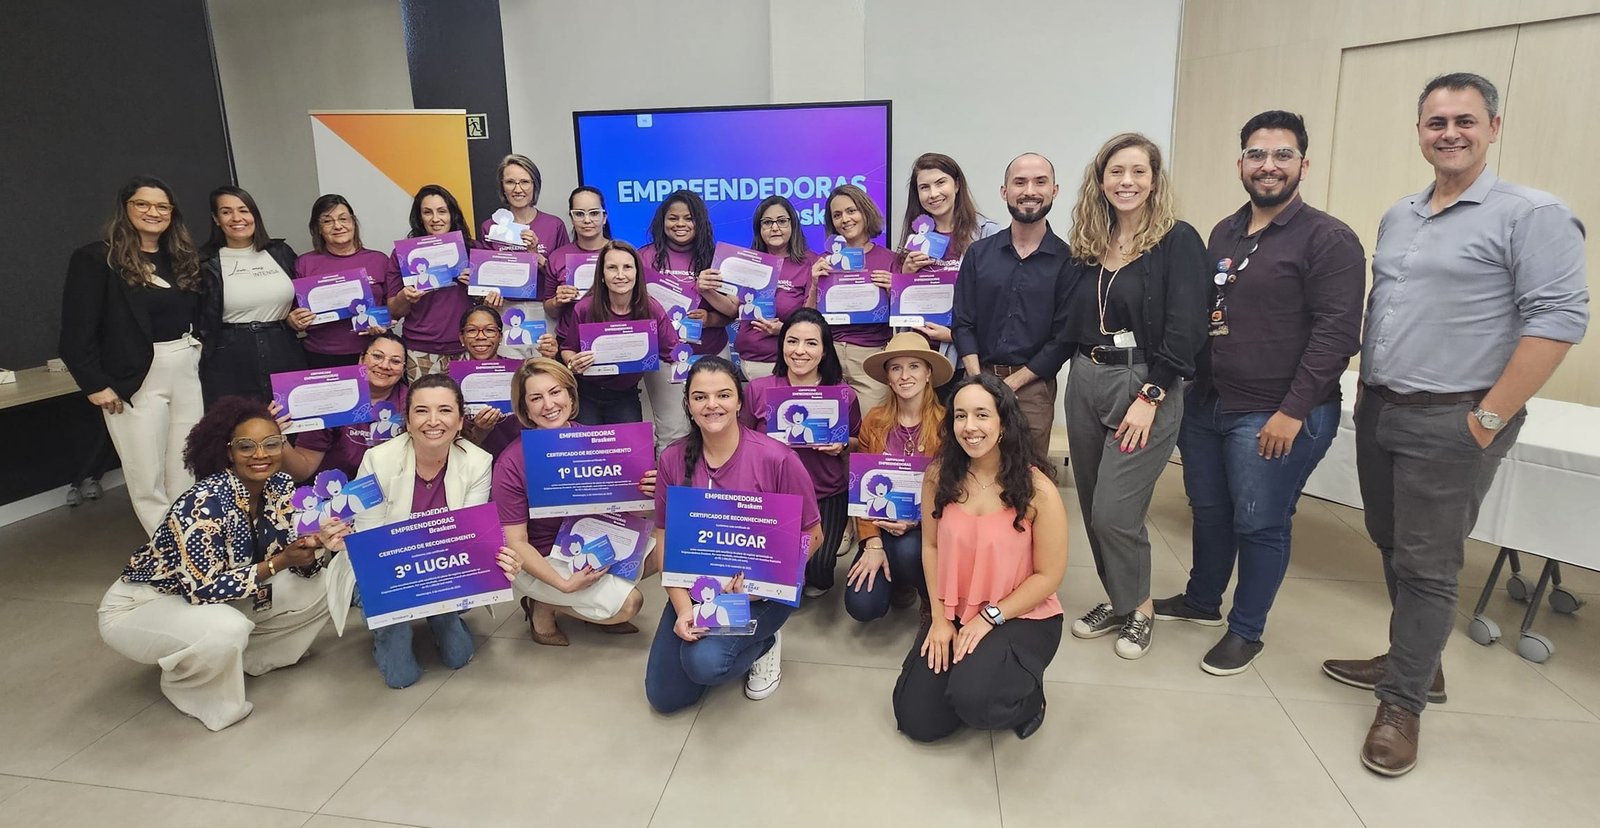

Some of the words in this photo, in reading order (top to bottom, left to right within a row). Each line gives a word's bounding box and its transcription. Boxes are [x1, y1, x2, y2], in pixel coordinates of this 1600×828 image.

[559, 429, 615, 439] EMPREENDEDORAS
[591, 436, 616, 444] Braskem
[546, 450, 578, 458] CERTIFICADO
[586, 447, 632, 456] RECONHECIMENTO
[557, 467, 571, 479] 1º
[574, 465, 622, 478] LUGAR
[704, 493, 763, 503] EMPREENDEDORAS
[737, 502, 763, 511] Braskem
[689, 511, 722, 521] CERTIFICADO
[730, 515, 778, 525] RECONHECIMENTO
[390, 516, 455, 536] EMPREENDEDORAS
[428, 524, 457, 534] Braskem
[698, 530, 713, 543] 2º
[716, 531, 766, 549] LUGAR
[378, 544, 416, 559] CERTIFICADO
[416, 542, 425, 550] DE
[425, 533, 476, 548] RECONHECIMENTO
[394, 563, 412, 579] 3º
[415, 552, 470, 575] LUGAR
